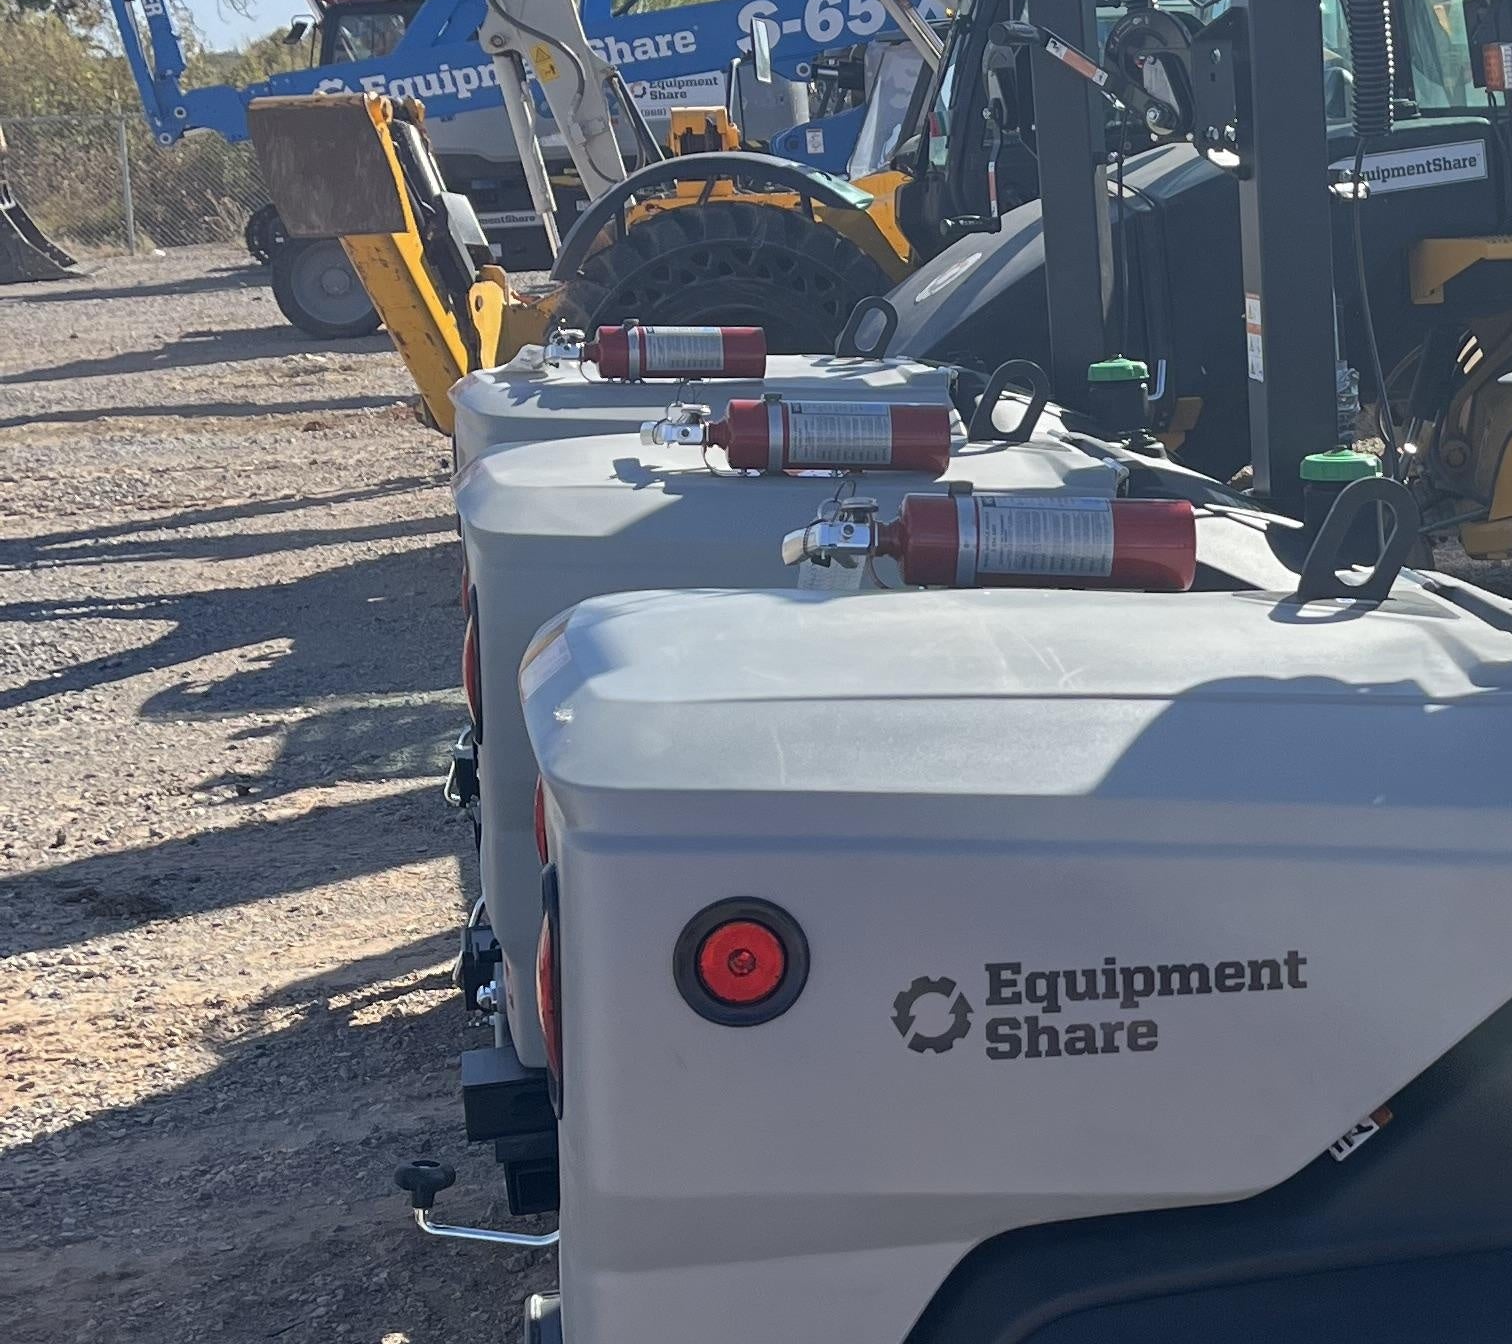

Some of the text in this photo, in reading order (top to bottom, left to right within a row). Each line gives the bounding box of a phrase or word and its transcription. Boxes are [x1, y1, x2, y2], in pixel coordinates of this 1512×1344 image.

[649, 77, 719, 90] Equipment
[649, 90, 687, 100] Share
[984, 950, 1308, 1013] Equipment
[984, 1015, 1159, 1060] Share
